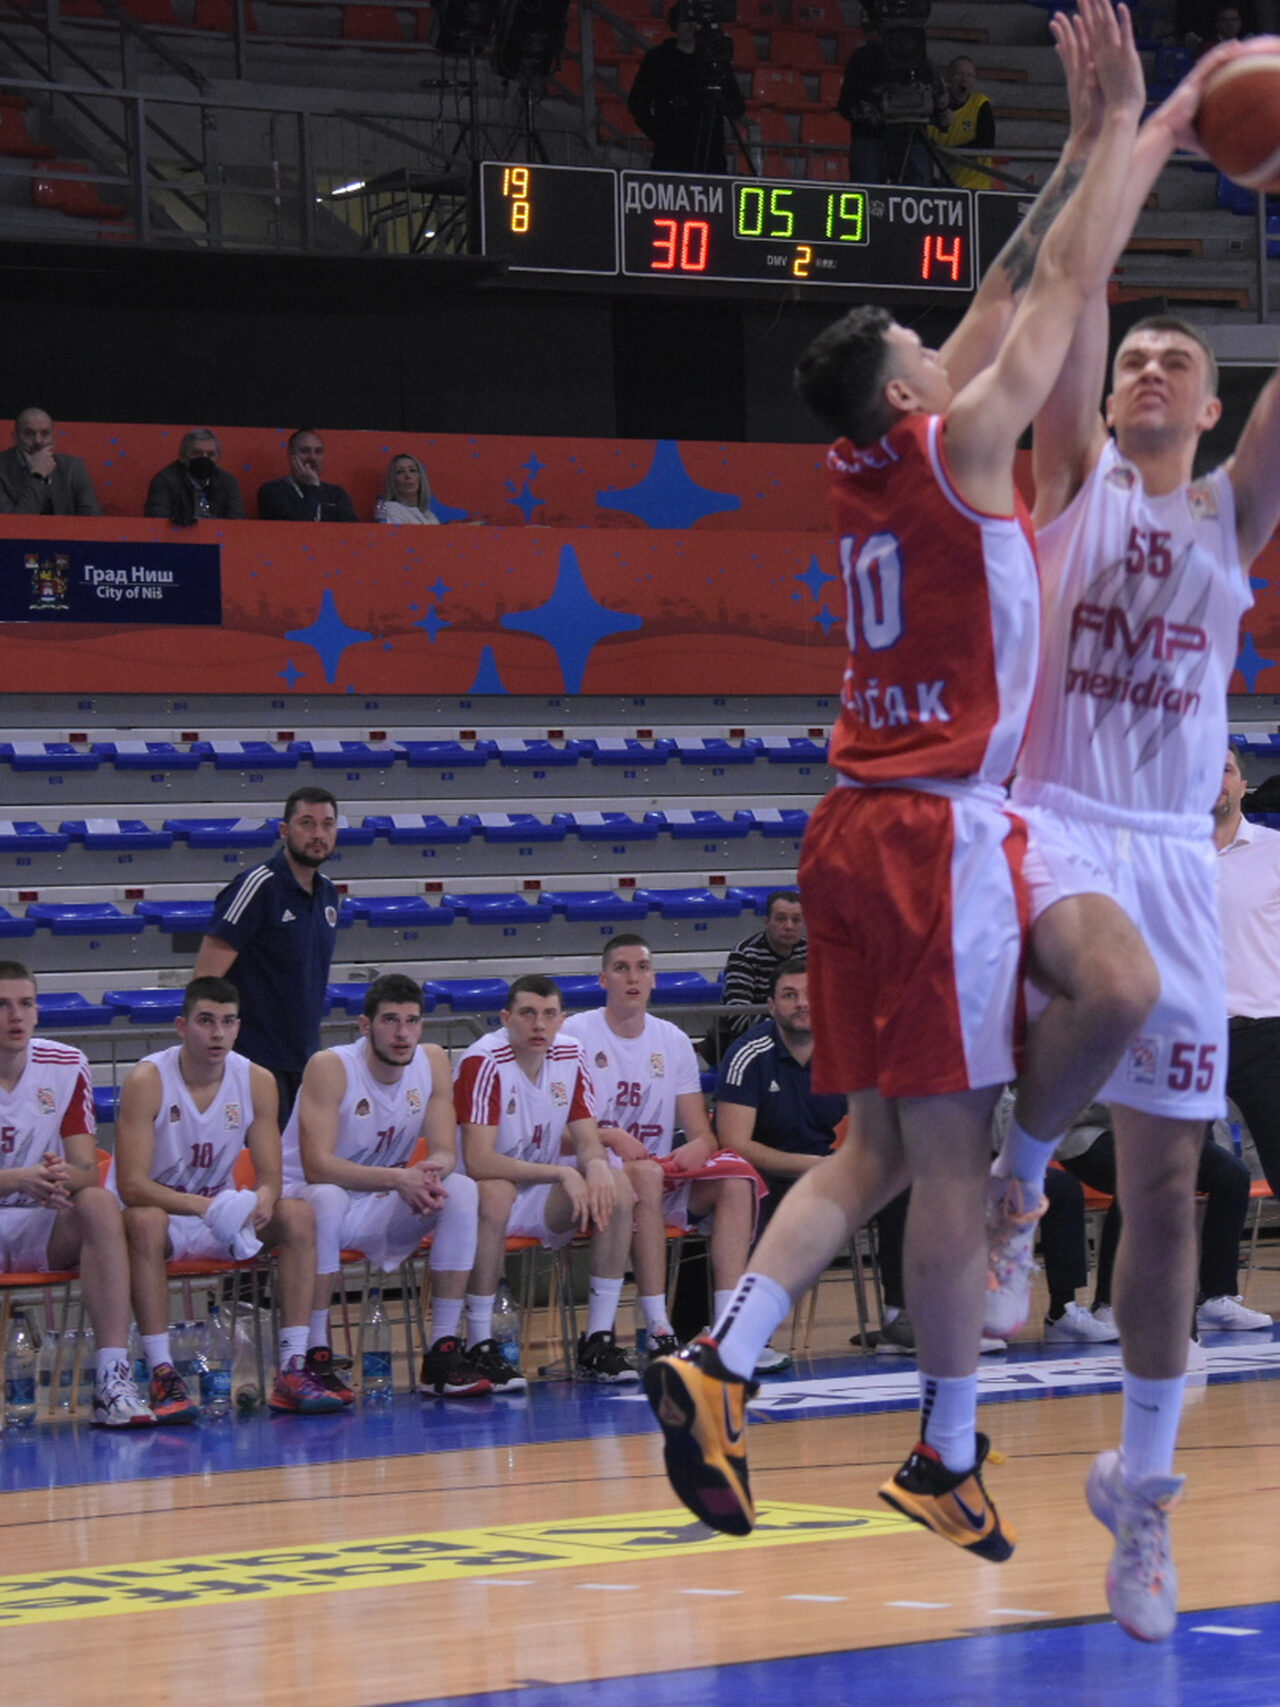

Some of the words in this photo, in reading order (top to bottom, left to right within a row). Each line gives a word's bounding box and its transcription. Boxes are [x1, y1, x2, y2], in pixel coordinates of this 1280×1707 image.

[503, 168, 528, 198] 19
[625, 181, 723, 214] ДОМАЋИ
[512, 201, 529, 232] 8
[738, 187, 793, 237] 05
[826, 193, 864, 241] 19
[889, 197, 963, 227] ГОСТИ
[651, 219, 709, 271] 30
[922, 235, 961, 281] 14
[793, 246, 811, 277] 2
[1126, 526, 1173, 579] 55
[84, 565, 128, 586] Град
[131, 566, 173, 583] Ниш
[840, 529, 905, 654] 10
[96, 586, 123, 602] City
[125, 586, 140, 599] of
[1071, 602, 1207, 662] FMP
[1168, 1042, 1217, 1092] 55
[616, 1081, 641, 1107] 26
[190, 1142, 213, 1168] 10
[375, 1126, 395, 1153] 71
[0, 1550, 572, 1620] Raiffe
